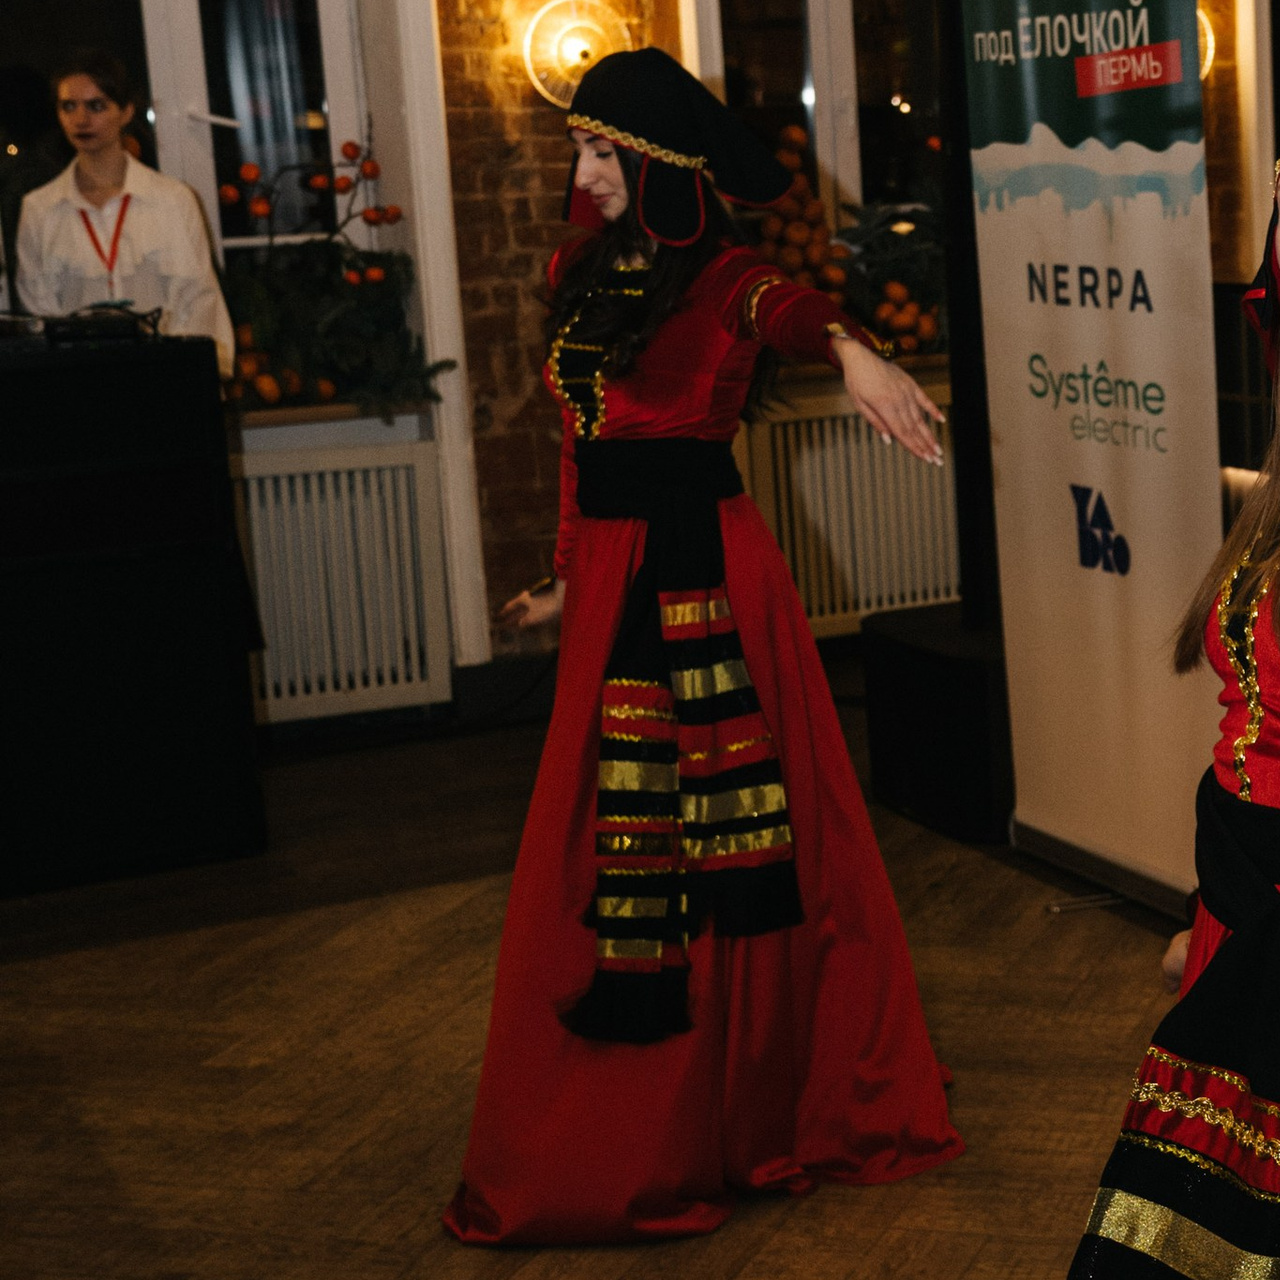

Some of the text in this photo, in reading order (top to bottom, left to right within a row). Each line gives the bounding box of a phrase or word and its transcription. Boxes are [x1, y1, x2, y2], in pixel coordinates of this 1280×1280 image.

[974, 31, 1015, 66] под
[1097, 51, 1163, 86] ПЕРМЬ
[1027, 262, 1153, 312] NERPA
[1028, 354, 1165, 415] Systême
[1069, 409, 1168, 453] electric
